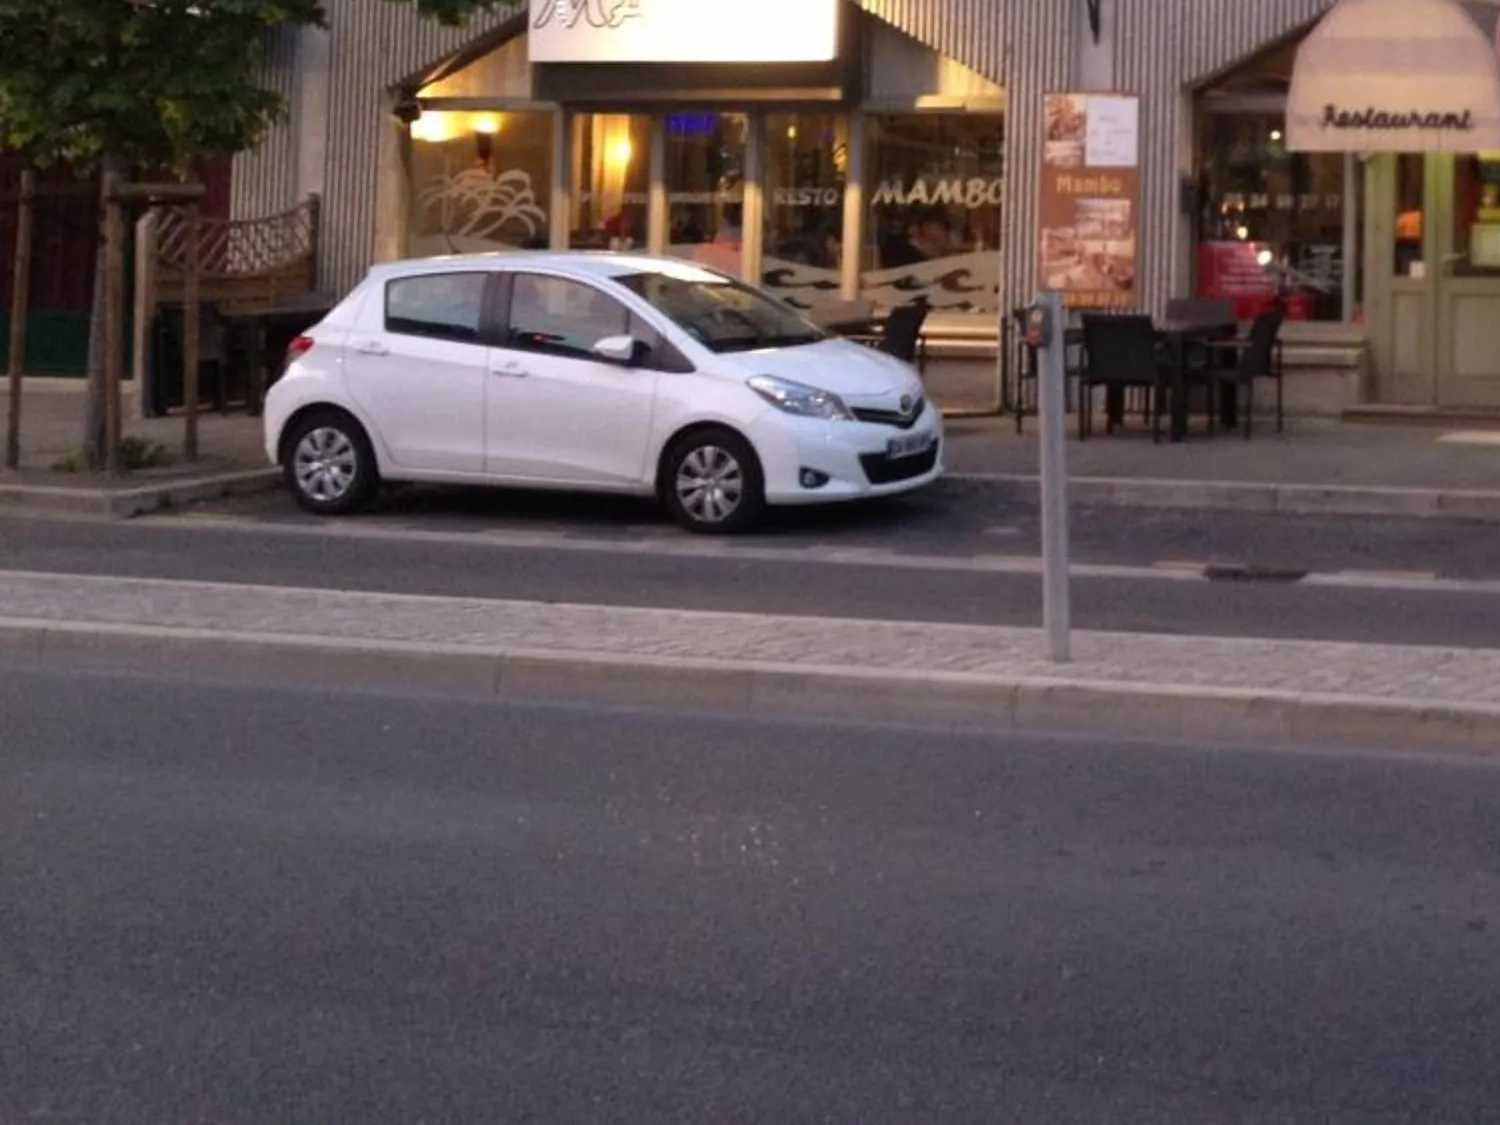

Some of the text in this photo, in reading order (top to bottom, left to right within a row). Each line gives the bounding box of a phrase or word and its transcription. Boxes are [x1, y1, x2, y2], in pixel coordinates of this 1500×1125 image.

[1321, 104, 1472, 132] Restaurant
[1056, 175, 1121, 193] Mambo
[772, 187, 839, 206] RESTO
